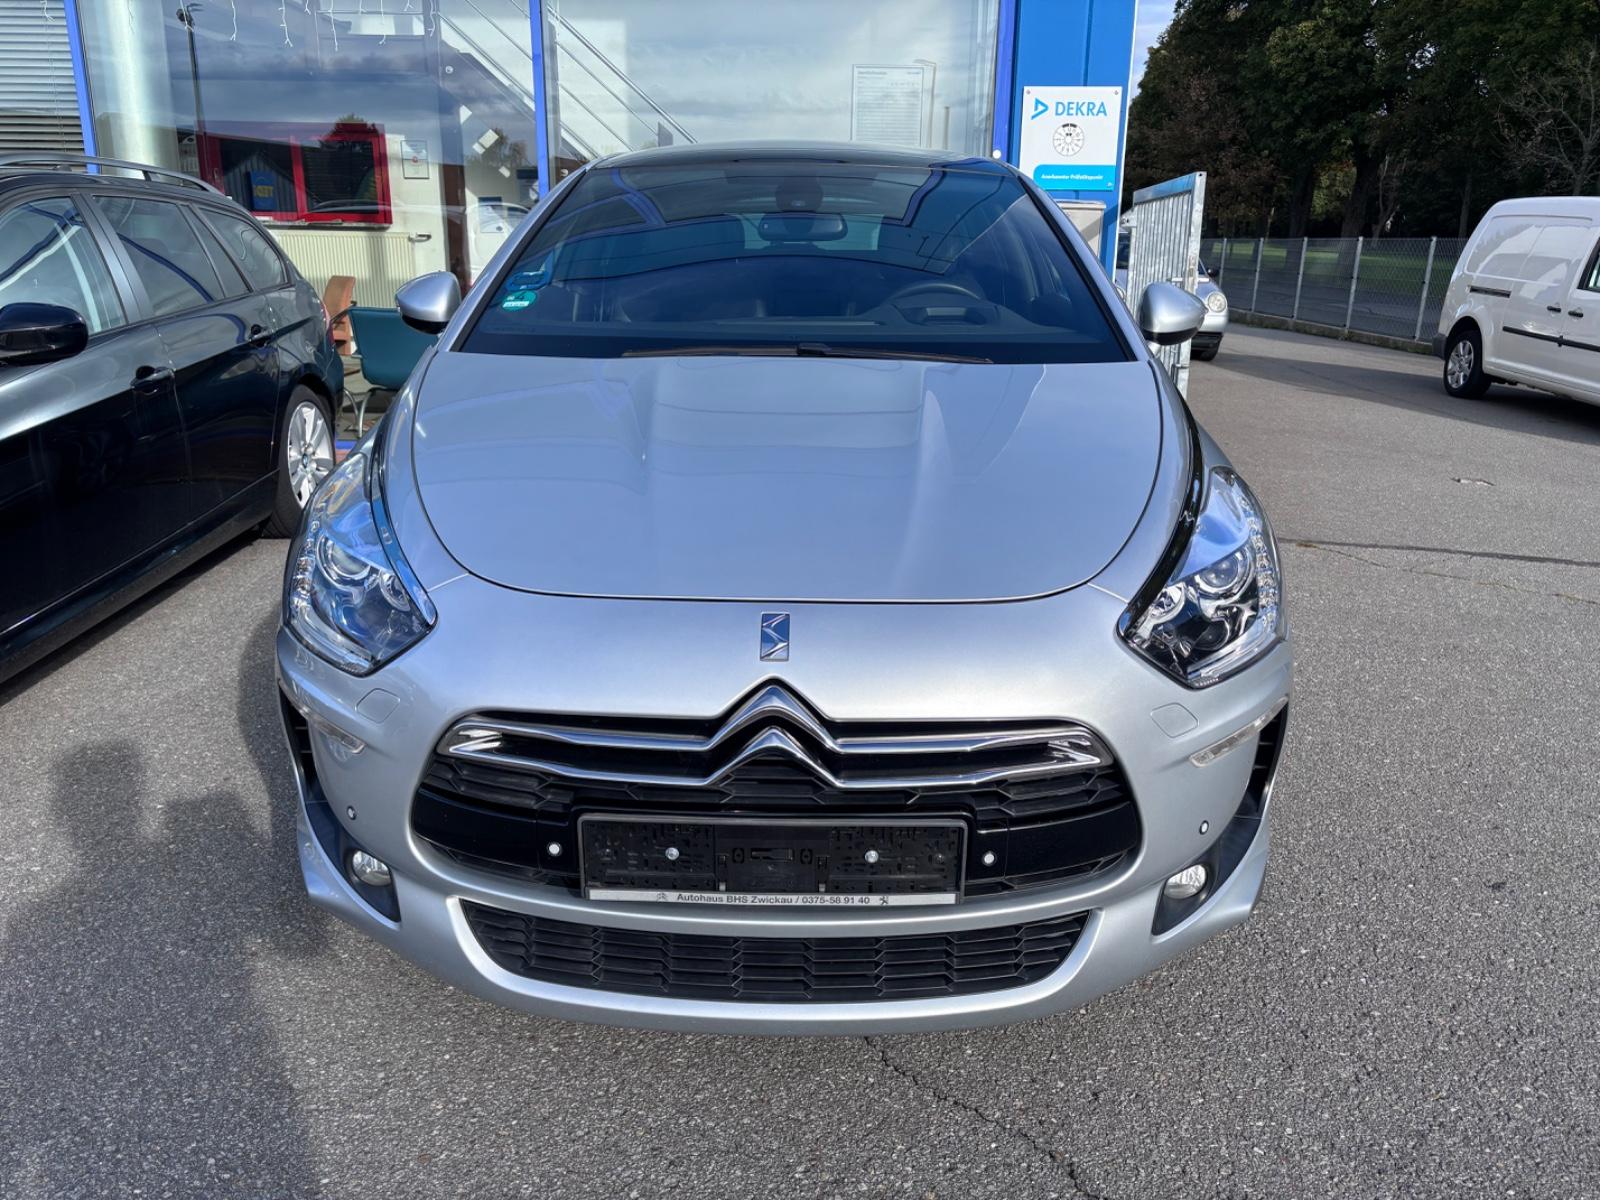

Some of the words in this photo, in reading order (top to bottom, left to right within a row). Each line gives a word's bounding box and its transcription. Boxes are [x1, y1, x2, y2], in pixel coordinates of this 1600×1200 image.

[1055, 101, 1107, 116] DEKRA
[677, 892, 723, 903] Autohaus
[726, 895, 748, 904] BHS
[751, 895, 792, 905] Zwickau
[801, 896, 841, 904] 0375-58
[843, 896, 855, 904] 91
[857, 896, 870, 904] 40
